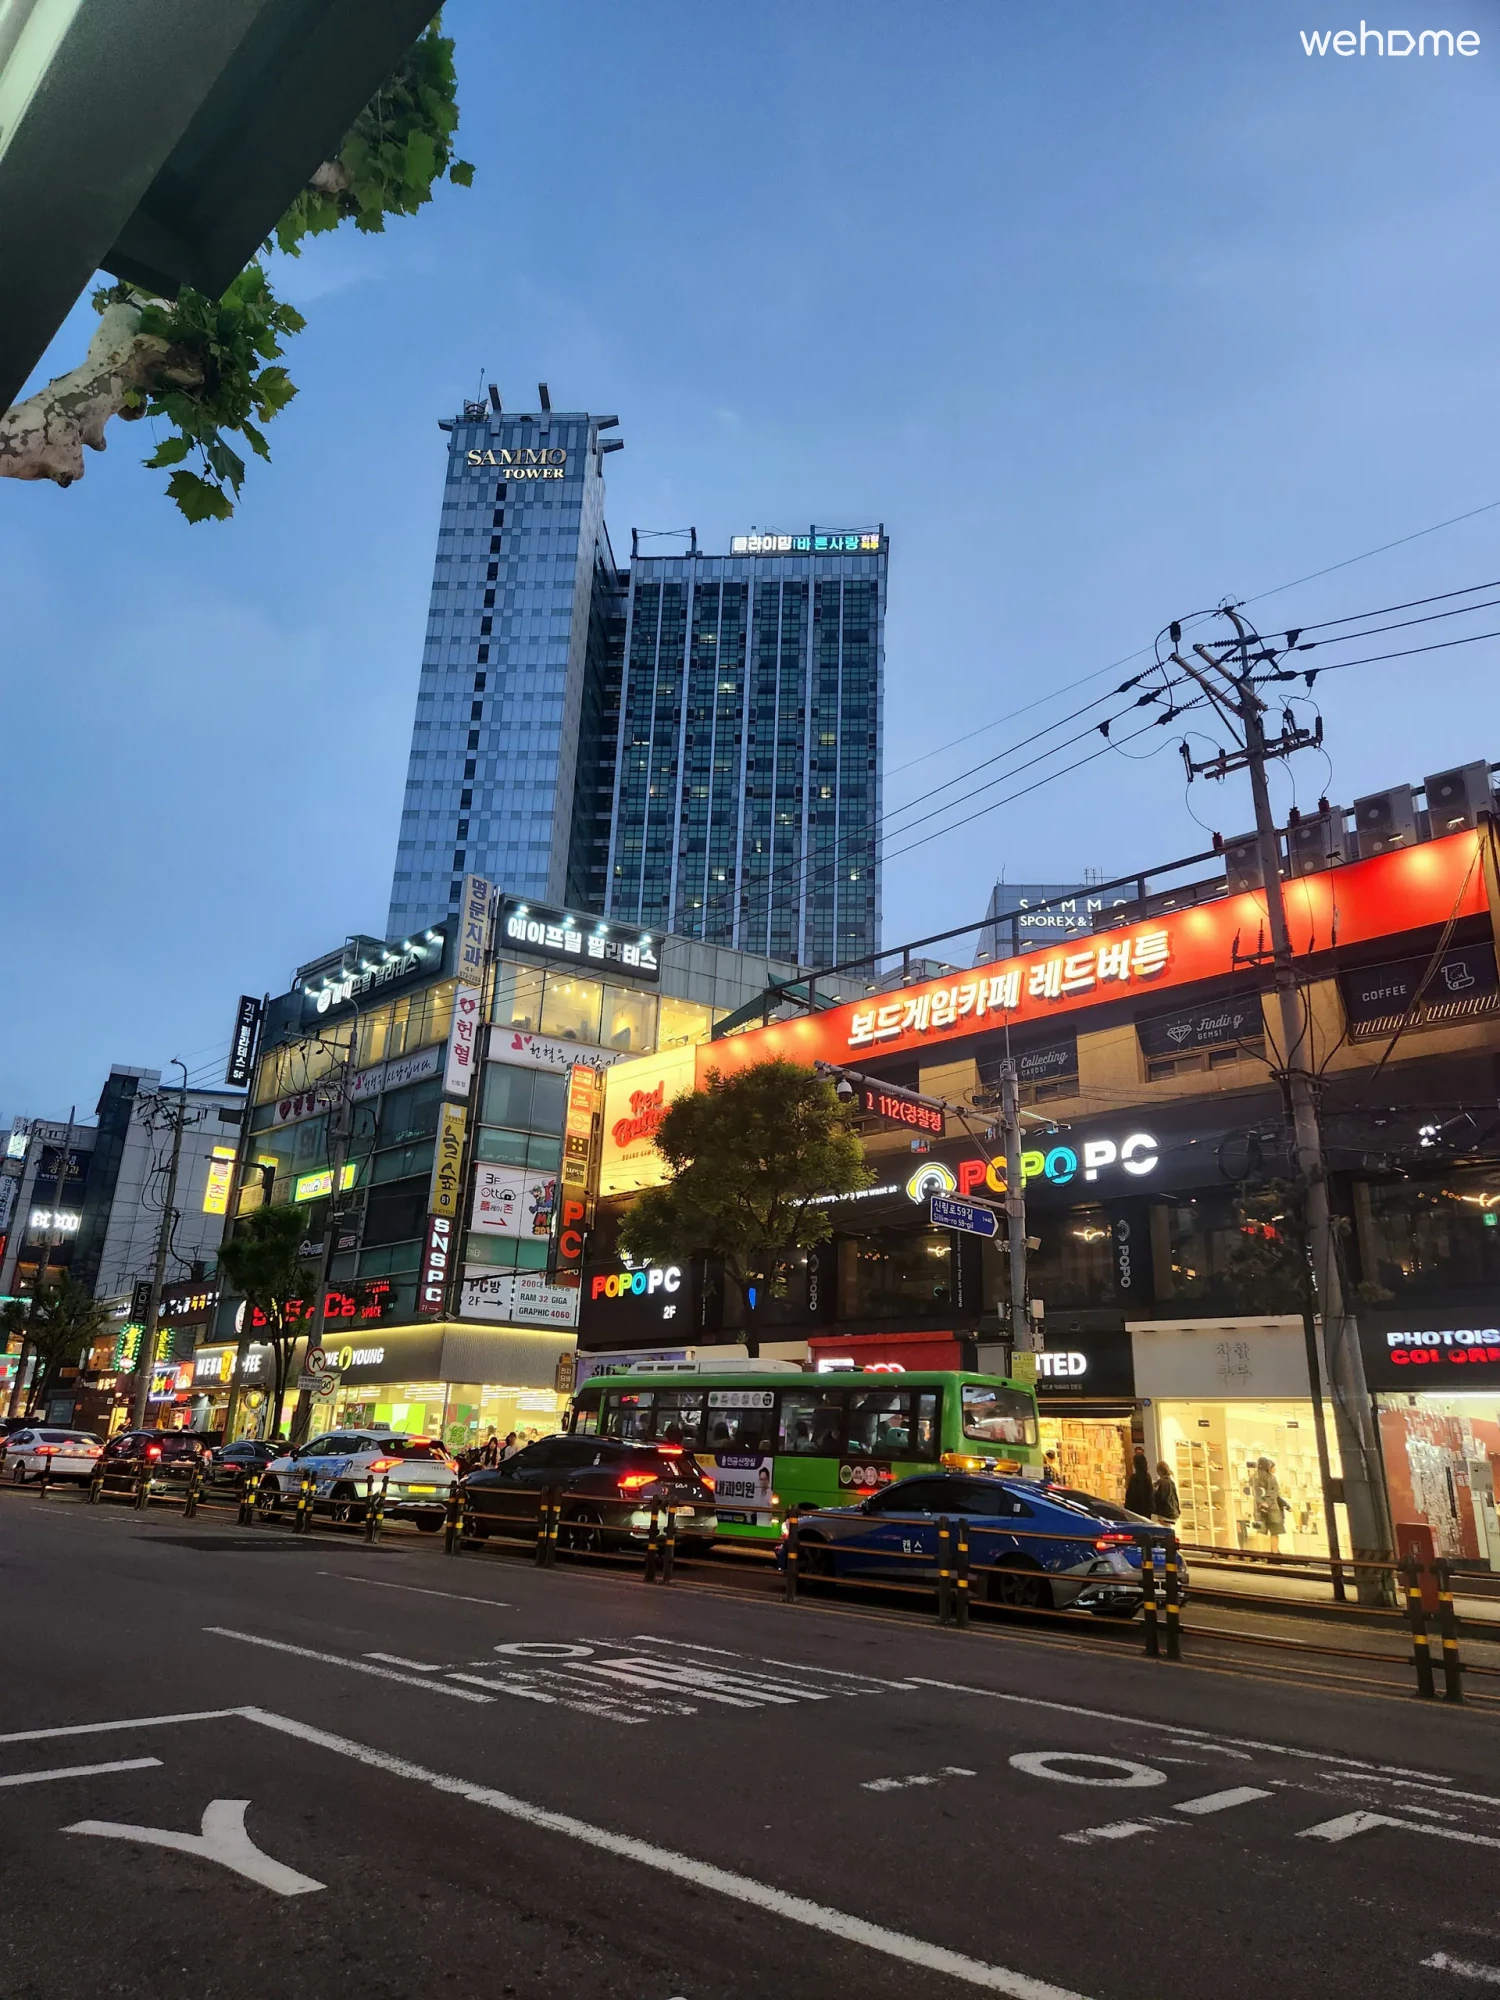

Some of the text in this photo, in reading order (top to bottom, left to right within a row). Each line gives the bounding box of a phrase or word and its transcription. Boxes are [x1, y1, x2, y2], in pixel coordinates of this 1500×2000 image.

[467, 448, 567, 466] SAMMO
[503, 468, 564, 479] TOWER
[1020, 916, 1076, 927] SPOREX
[508, 917, 657, 971] 에이프릴 필라테스
[848, 930, 1170, 1046] 보드게임카페 레드버튼
[1362, 984, 1407, 1002] COFFEE
[1196, 1012, 1244, 1032] Finding
[235, 1002, 255, 1067] 기구 필라테스
[454, 1019, 473, 1066] 헌혈
[1197, 1029, 1222, 1040] GEMS!
[529, 1043, 567, 1064] 헌혈은
[1020, 1051, 1068, 1069] Collecting
[233, 1069, 245, 1079] 5F
[629, 1080, 665, 1113] Red
[959, 1133, 1159, 1196] POPO PC
[485, 1173, 501, 1184] 3F
[856, 1190, 868, 1200] you
[868, 1186, 888, 1197] want
[888, 1185, 898, 1193] at
[934, 1200, 973, 1220] 신림로59길
[560, 1200, 584, 1259] PC
[425, 1218, 450, 1302] SNSPC
[1118, 1245, 1132, 1288] POPO
[591, 1271, 647, 1300] POPO
[647, 1266, 681, 1294] PC
[468, 1295, 481, 1306] 2F
[520, 1293, 568, 1305] RAM 32 GIGA
[809, 1276, 818, 1311] POPO
[519, 1307, 570, 1319] GRAPHIC 4060
[663, 1305, 677, 1320] 2F
[352, 1347, 385, 1366] YOUNG
[727, 1455, 756, 1467] 인공신장실
[715, 1480, 755, 1499] 내과의원
[902, 1539, 923, 1553] 캡스
